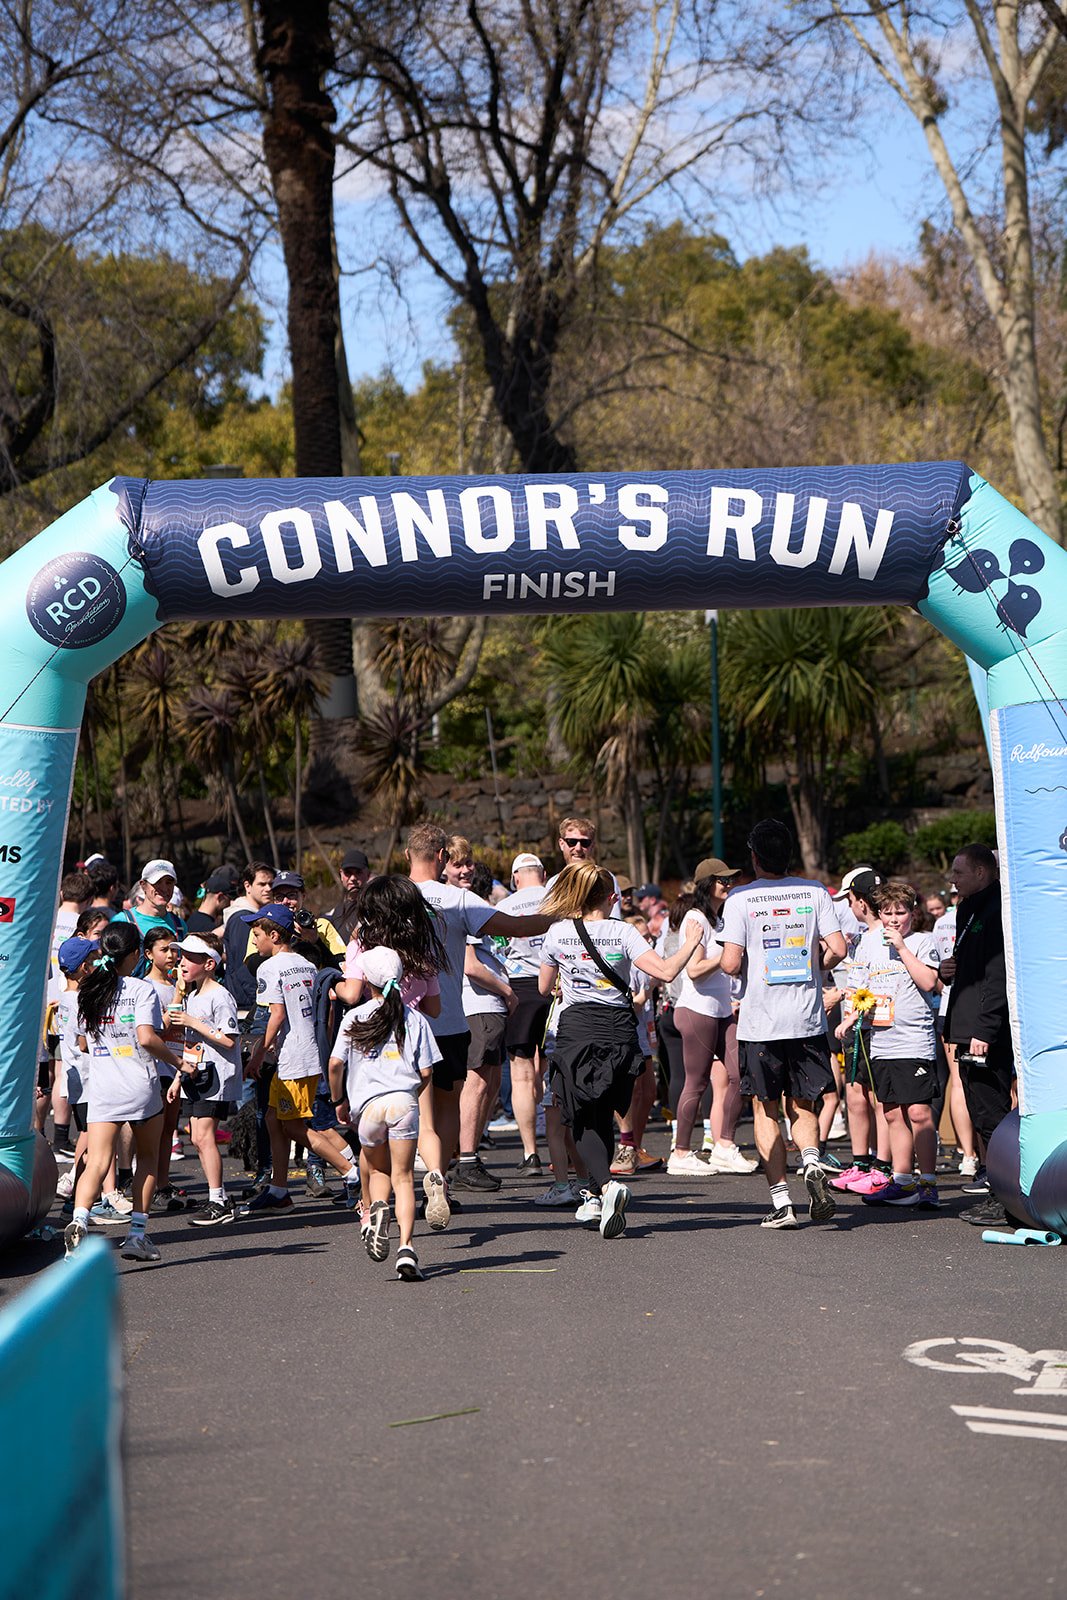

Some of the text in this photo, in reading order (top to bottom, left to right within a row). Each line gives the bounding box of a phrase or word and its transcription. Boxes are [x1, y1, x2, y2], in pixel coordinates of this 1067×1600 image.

[198, 483, 895, 598] CONNOR'S RUN
[45, 577, 102, 626] RCD
[482, 571, 616, 600] FINISH
[36, 799, 54, 814] BY
